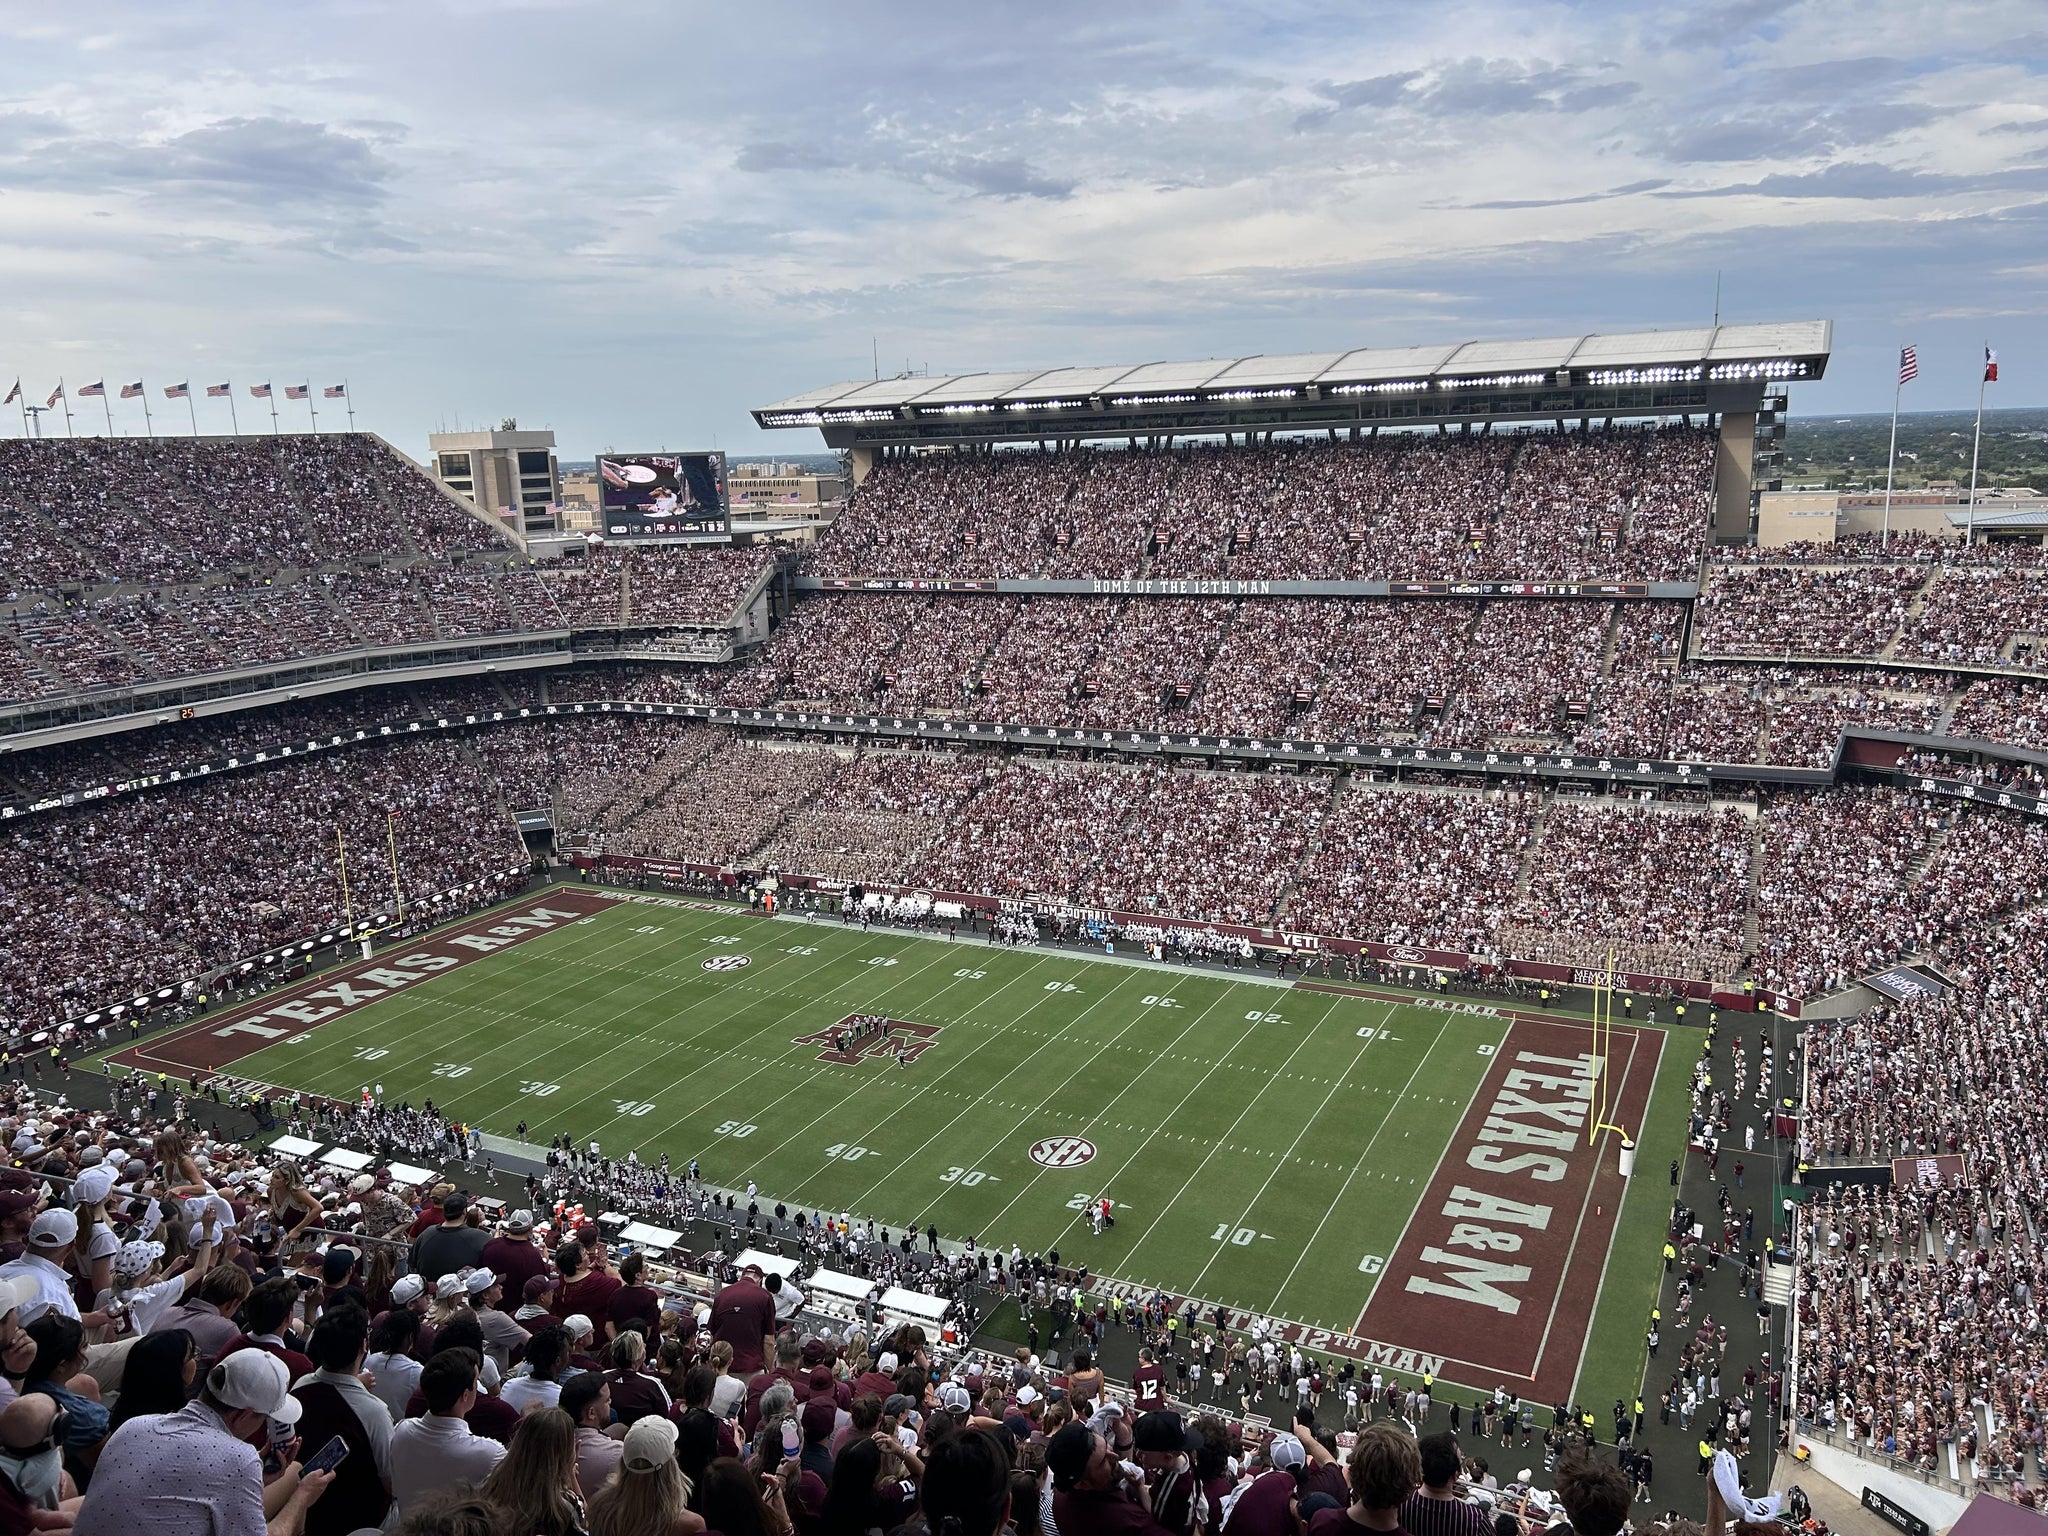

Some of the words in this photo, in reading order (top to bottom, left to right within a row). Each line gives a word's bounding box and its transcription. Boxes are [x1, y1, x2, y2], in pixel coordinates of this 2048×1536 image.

[1093, 580, 1130, 593] HOME
[1137, 581, 1153, 594] OF
[1160, 581, 1188, 594] THE
[1194, 581, 1230, 594] 12TH
[1237, 581, 1270, 594] MAN
[182, 709, 194, 719] 25
[28, 799, 61, 812] 15:00
[648, 862, 664, 871] Google
[664, 864, 681, 872] Gemini
[1037, 904, 1057, 915] A&M
[1060, 907, 1114, 923] FOOTBALL
[635, 925, 665, 935] 10
[708, 935, 742, 945] 20
[1280, 933, 1319, 949] YETI
[786, 945, 820, 956] 30
[1393, 948, 1419, 962] Ford
[704, 955, 751, 972] SEC
[867, 957, 899, 968] 40
[211, 952, 461, 1041] TEXAS
[448, 907, 582, 951] A&M
[953, 968, 987, 980] 50
[1575, 969, 1629, 982] MEMORIAL
[1043, 980, 1077, 994] 40
[1141, 994, 1177, 1008] 30
[1414, 998, 1499, 1016] GRIND
[1244, 1009, 1284, 1025] 20
[1356, 1026, 1391, 1042] 10
[352, 1047, 389, 1061] 10
[1477, 1044, 1496, 1056] G
[432, 1063, 472, 1078] 20
[520, 1081, 561, 1098] 30
[615, 1100, 657, 1117] 40
[1466, 1051, 1607, 1183] TEXAS
[714, 1121, 758, 1138] 50
[825, 1143, 868, 1161] 40
[1033, 1138, 1093, 1166] SEC
[939, 1167, 987, 1187] 30
[1210, 1223, 1257, 1246] 10
[1405, 1185, 1555, 1316] A&M
[1358, 1254, 1384, 1275] G
[1087, 1278, 1175, 1306] HOM
[1177, 1299, 1220, 1321] OF
[1295, 1327, 1363, 1350] 12TH
[1364, 1343, 1446, 1377] MAN
[1141, 1379, 1158, 1400] 12
